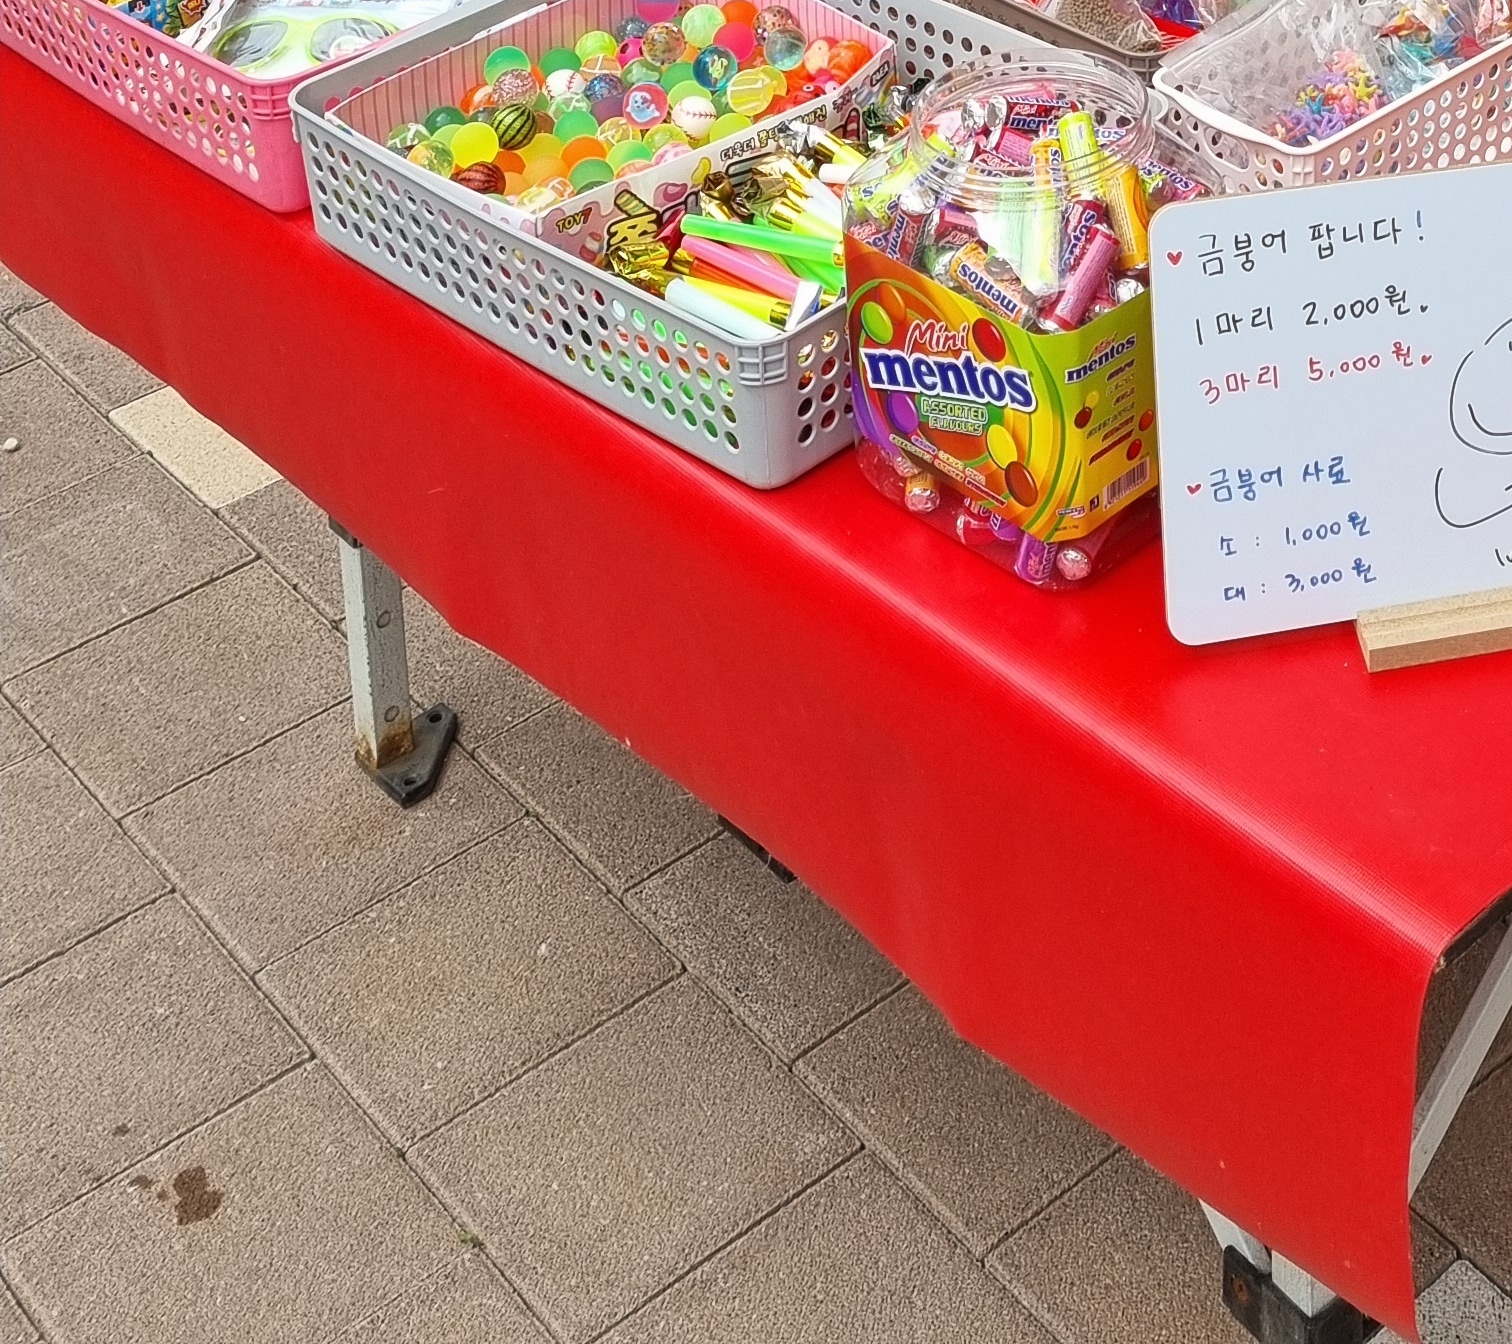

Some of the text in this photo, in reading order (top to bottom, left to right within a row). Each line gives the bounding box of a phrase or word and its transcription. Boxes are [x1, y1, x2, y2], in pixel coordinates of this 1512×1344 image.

[1197, 227, 1289, 276] 금붕어
[956, 261, 1020, 318] mentos
[905, 318, 970, 358] Mini
[1194, 305, 1275, 346] 1마리
[863, 350, 1034, 409] mentos
[1066, 334, 1137, 383] mentos
[1198, 364, 1280, 405] 3마리
[921, 398, 988, 423] ASSORTED
[1208, 454, 1352, 503] 금붕어 사료
